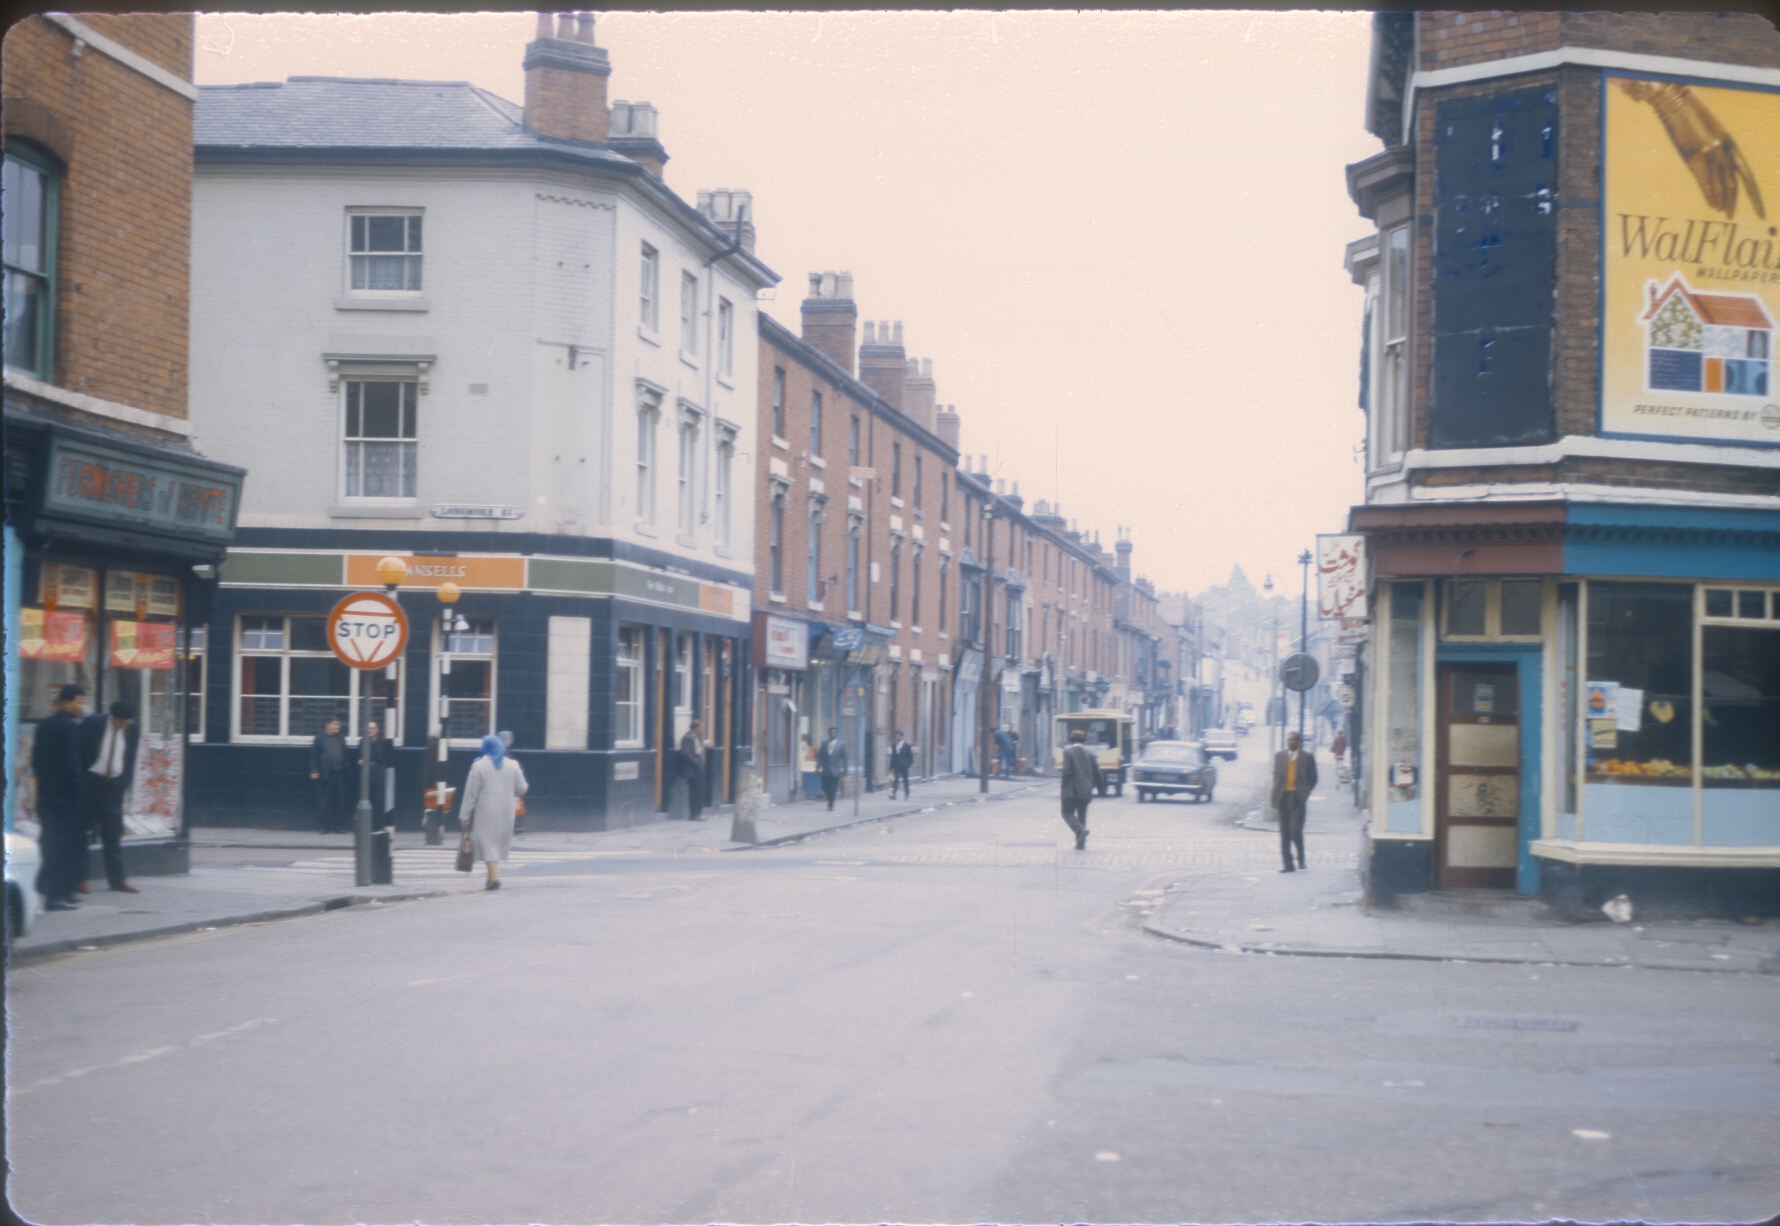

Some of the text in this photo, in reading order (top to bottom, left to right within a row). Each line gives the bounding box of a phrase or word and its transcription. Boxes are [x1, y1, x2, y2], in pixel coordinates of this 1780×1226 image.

[1633, 404, 1683, 417] PERFECT
[1685, 407, 1740, 420] PATTERNS
[338, 622, 396, 639] STOP
